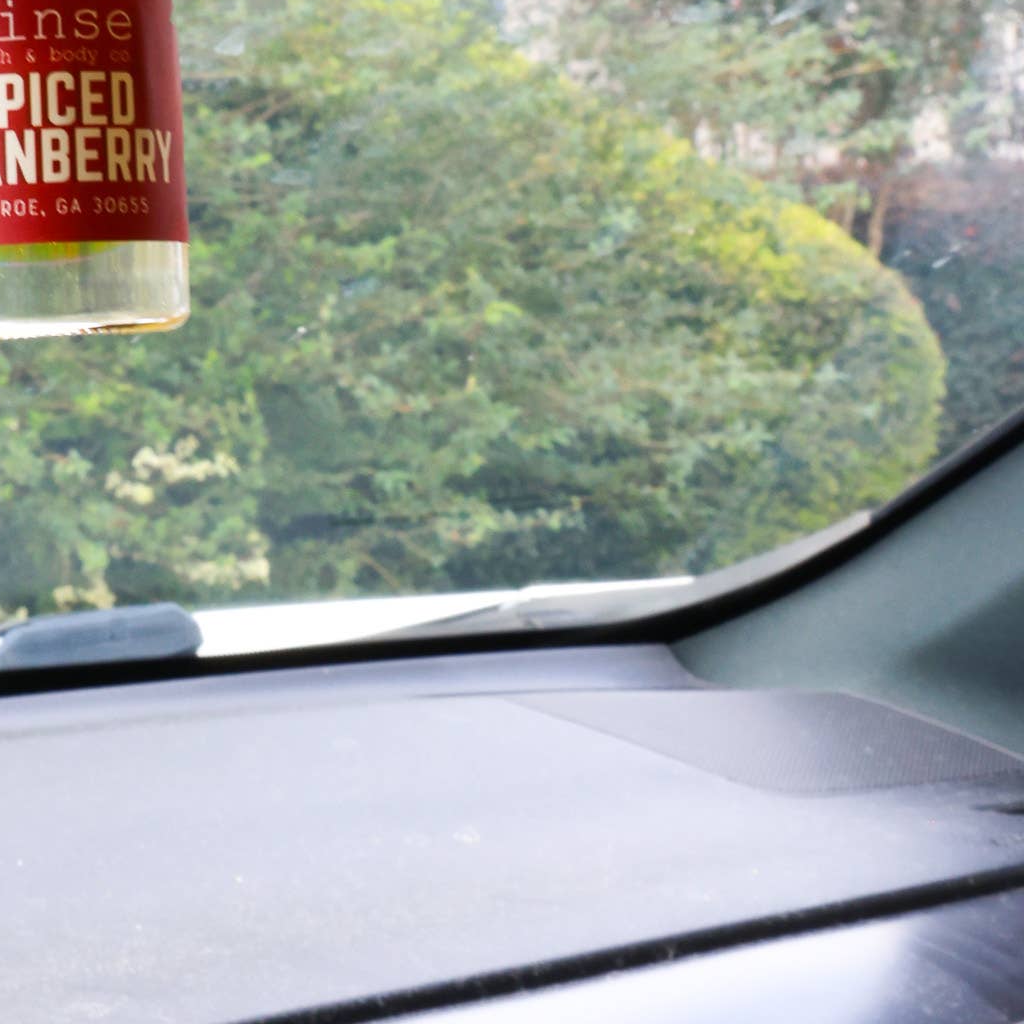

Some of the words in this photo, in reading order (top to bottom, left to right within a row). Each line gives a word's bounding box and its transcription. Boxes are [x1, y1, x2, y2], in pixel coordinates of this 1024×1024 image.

[24, 48, 37, 63] &
[49, 46, 99, 65] body
[55, 197, 83, 214] GA
[92, 196, 151, 214] 30655
